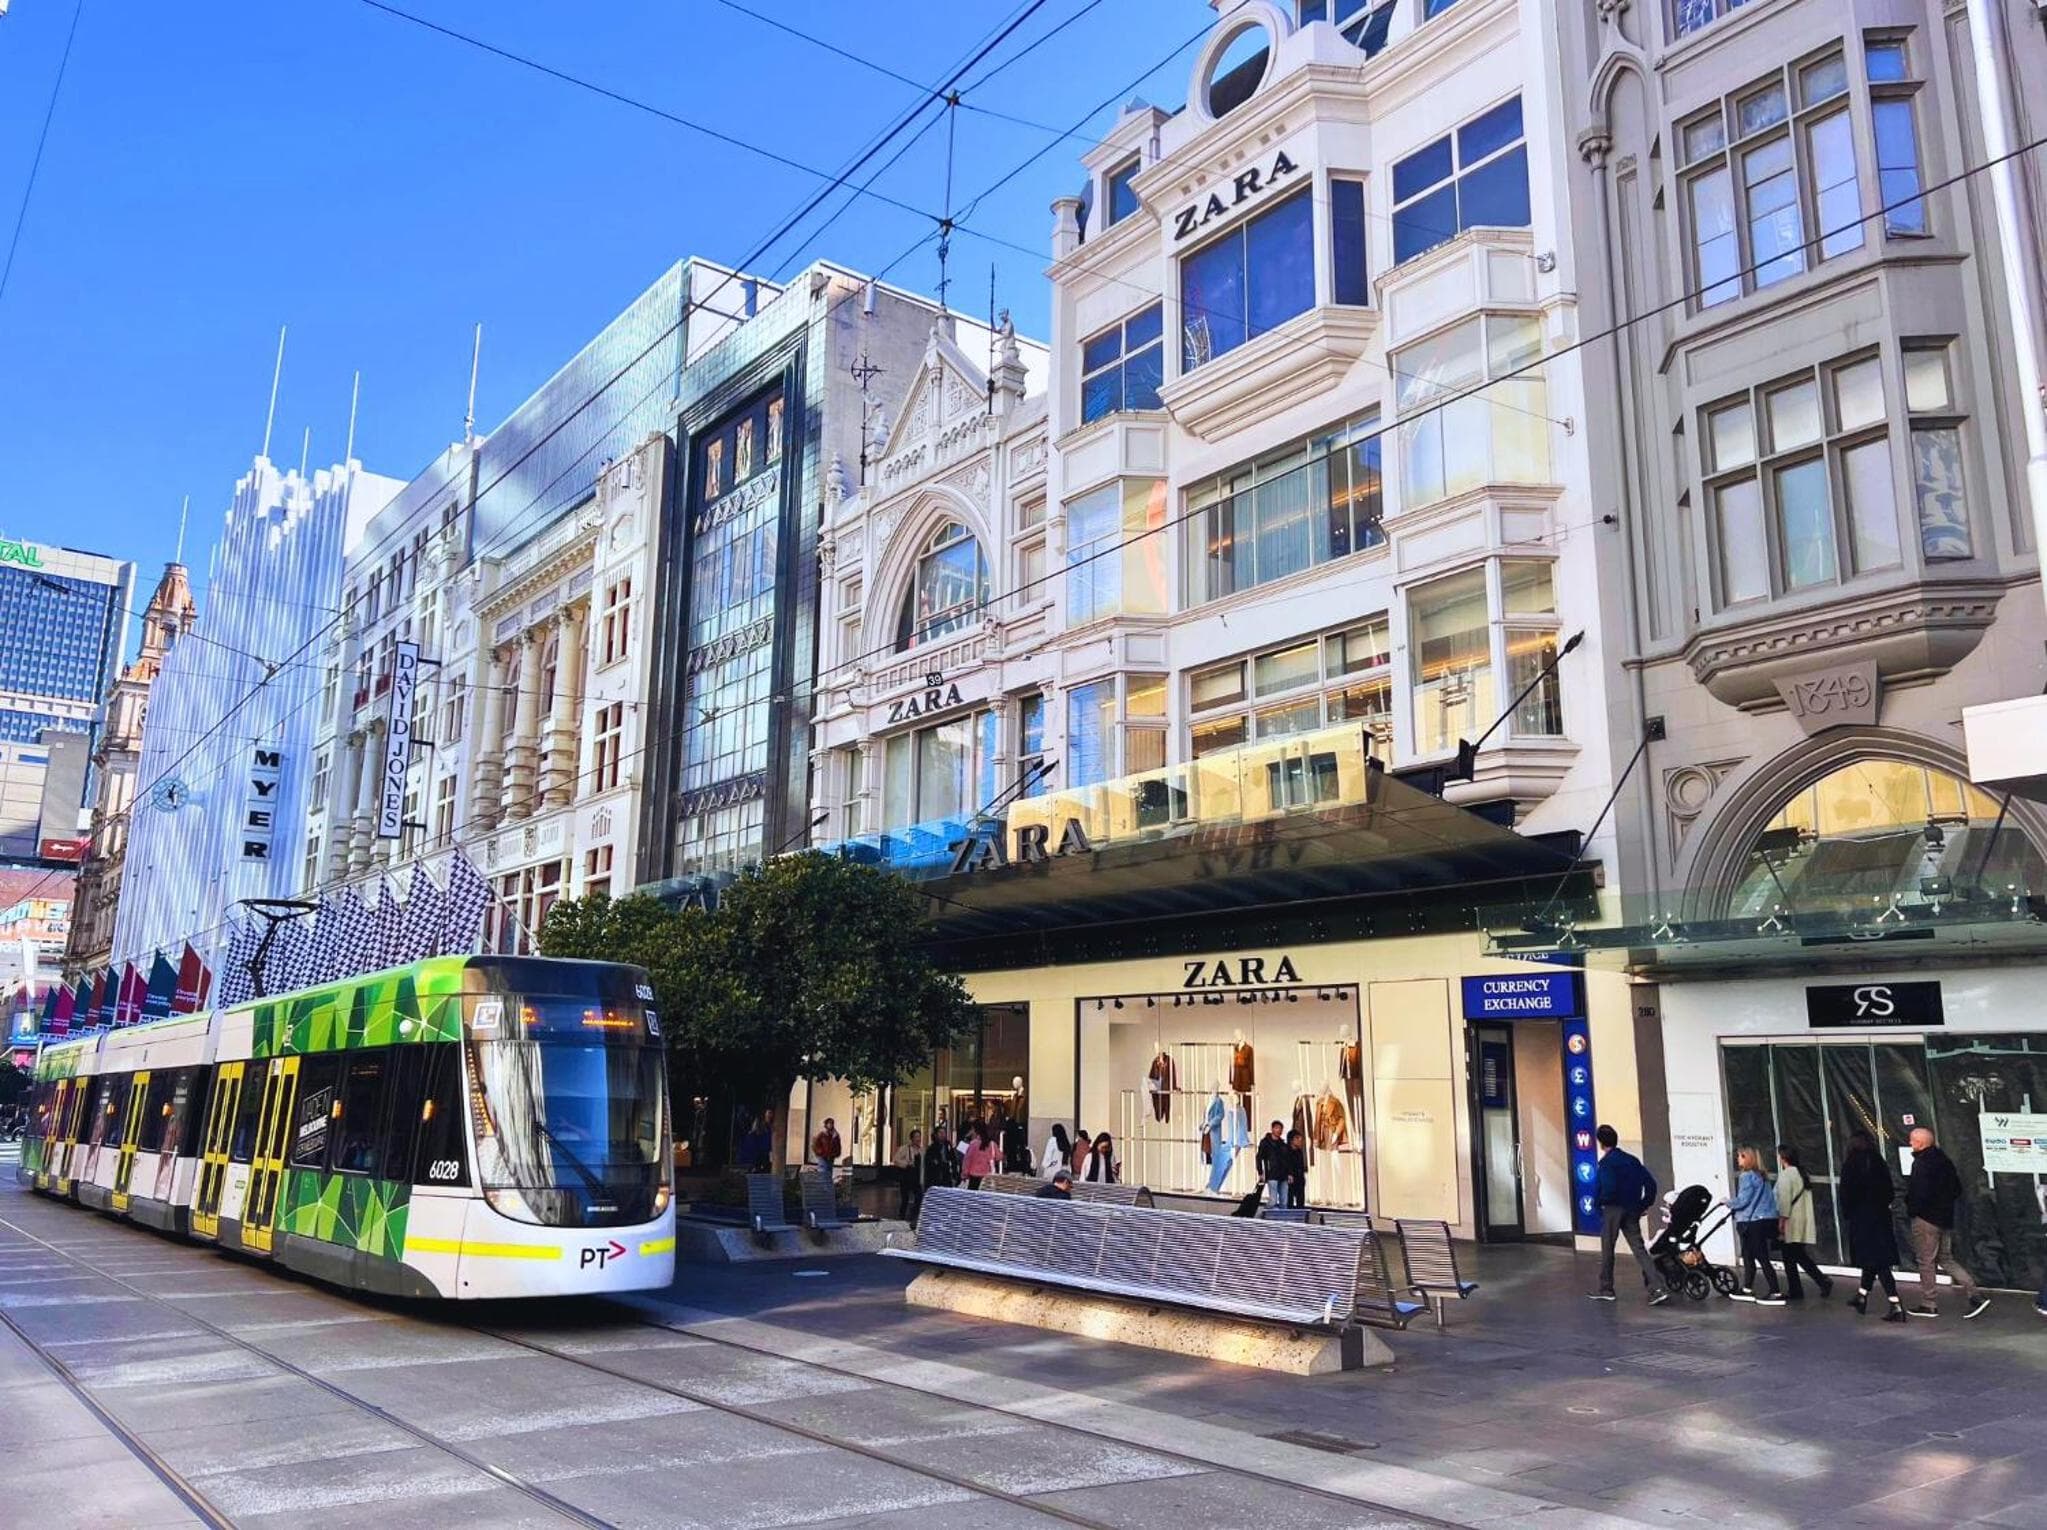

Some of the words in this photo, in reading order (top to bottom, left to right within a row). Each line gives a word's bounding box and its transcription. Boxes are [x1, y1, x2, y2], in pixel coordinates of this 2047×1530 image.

[1174, 150, 1299, 241] ZARA
[392, 653, 415, 735] DAVID
[928, 675, 941, 686] 39
[888, 683, 964, 723] ZARA
[243, 750, 280, 858] MYER
[384, 741, 405, 828] JONES
[948, 817, 1093, 874] ZARA
[1184, 955, 1302, 988] ZARA
[1483, 979, 1550, 994] CURRENCY
[1484, 996, 1553, 1011] EXCHANGE
[430, 1160, 459, 1180] 6028
